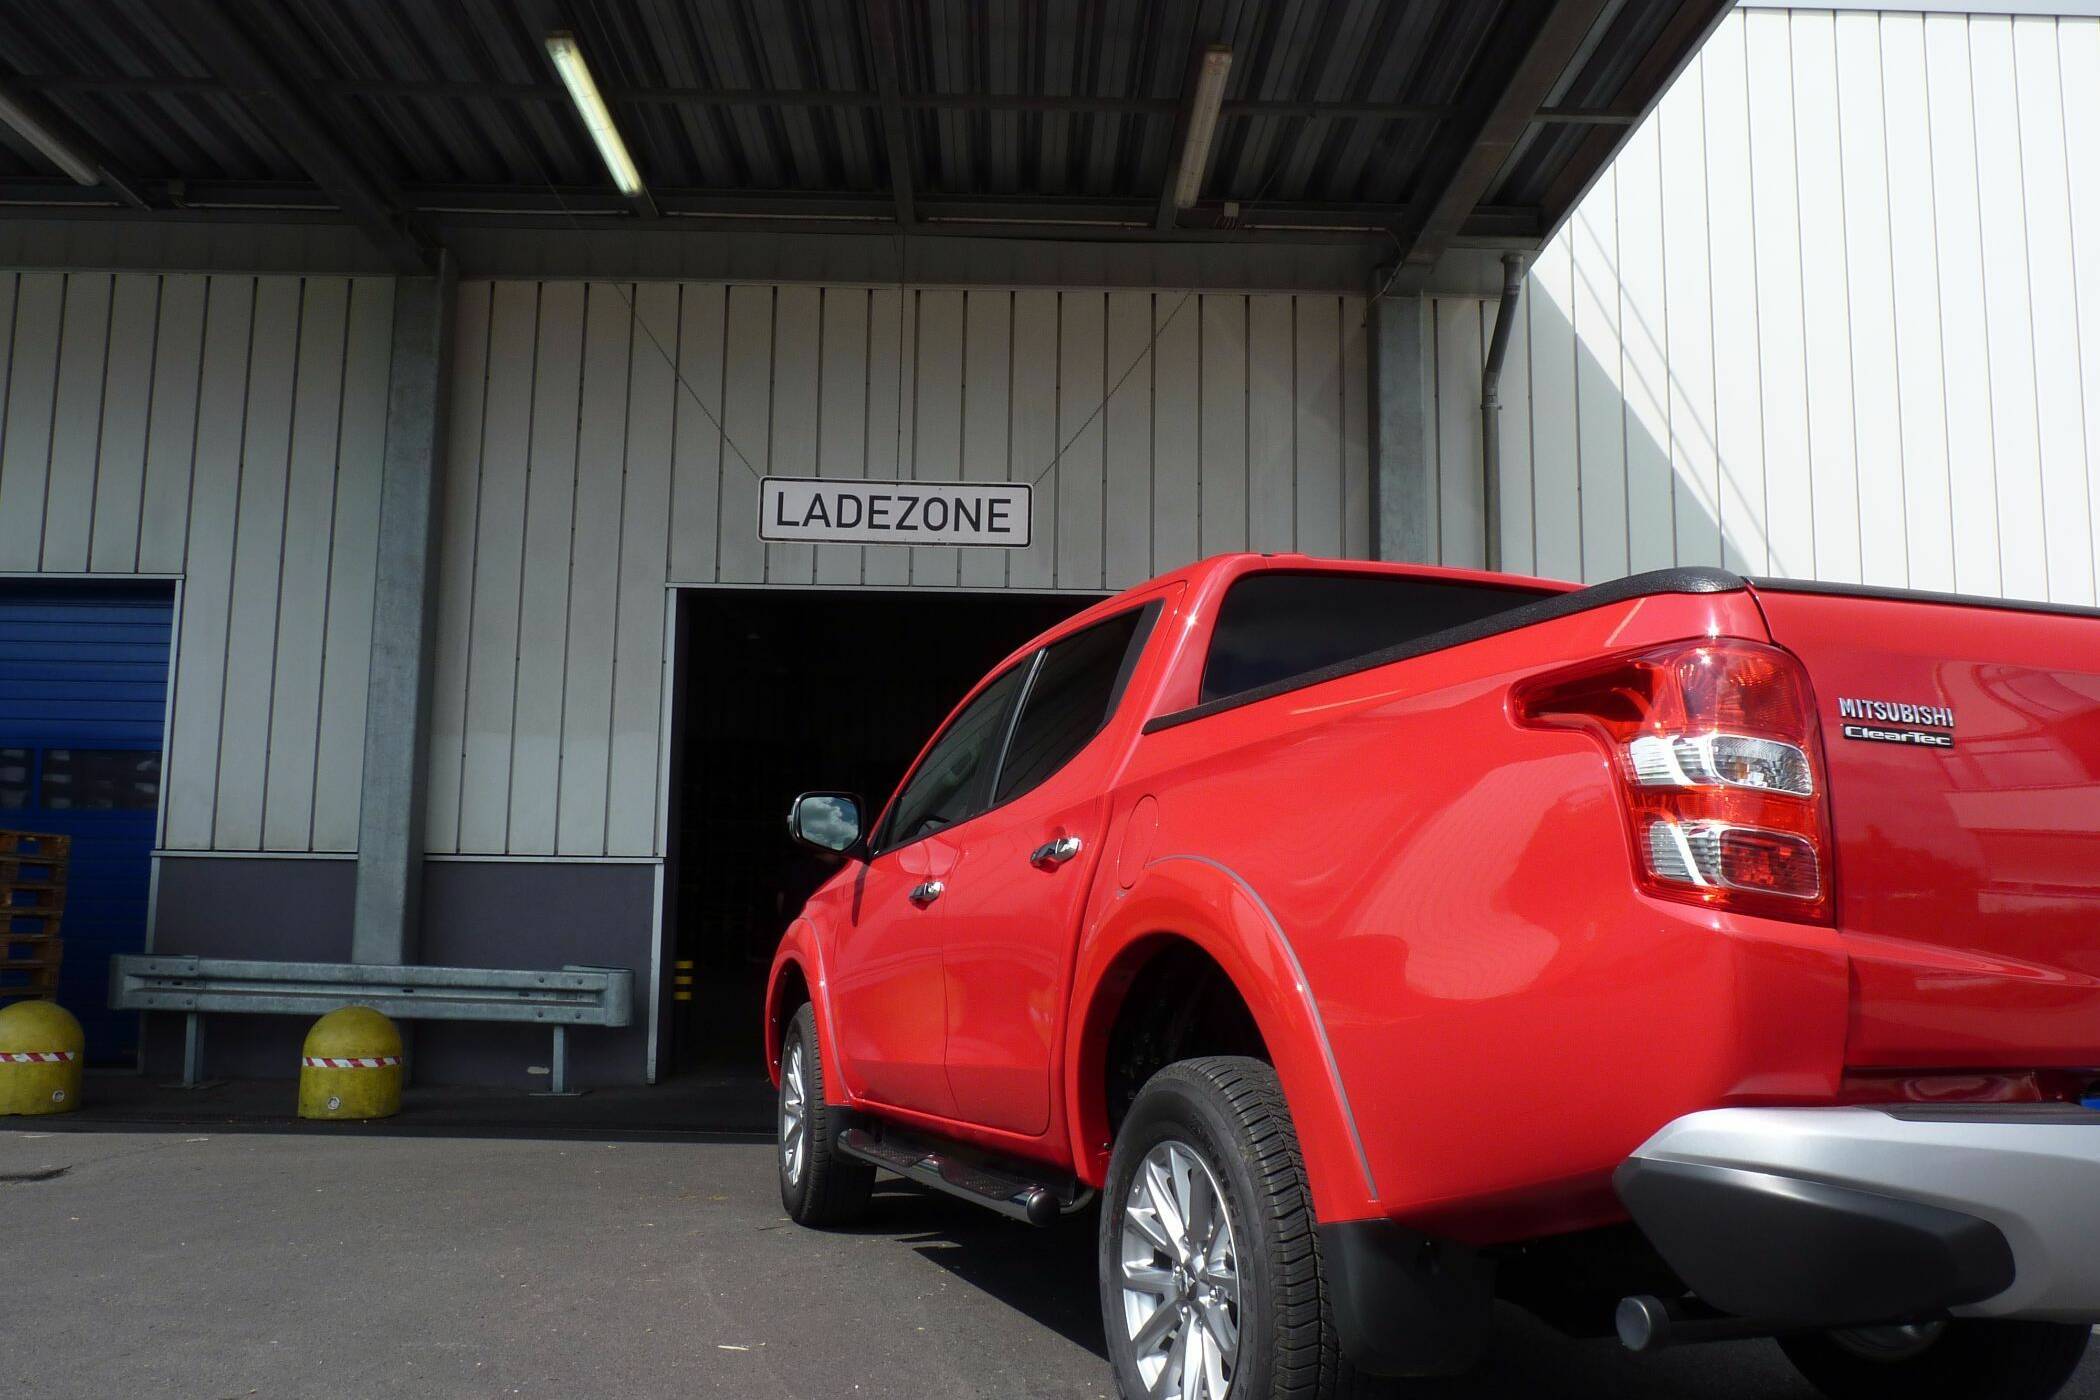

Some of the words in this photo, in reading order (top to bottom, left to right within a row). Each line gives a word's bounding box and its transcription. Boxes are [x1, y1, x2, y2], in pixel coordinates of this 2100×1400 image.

[776, 491, 1012, 533] LADEZONE
[1838, 697, 1955, 727] MITSUBISHI
[1844, 725, 1952, 746] ClearTec
